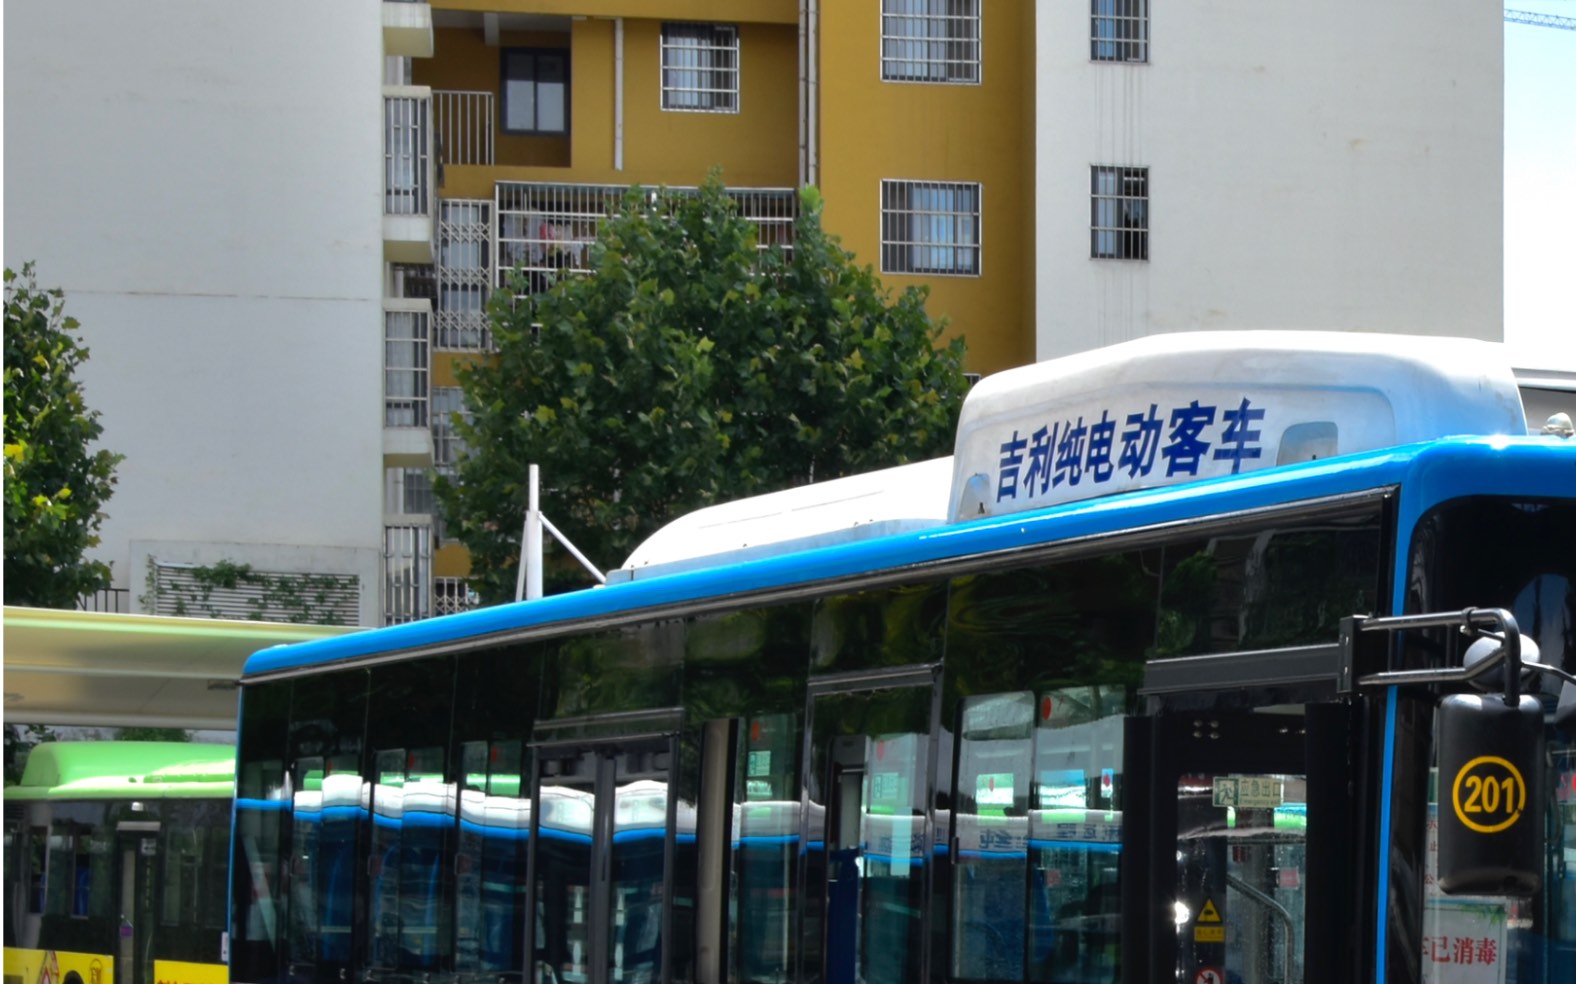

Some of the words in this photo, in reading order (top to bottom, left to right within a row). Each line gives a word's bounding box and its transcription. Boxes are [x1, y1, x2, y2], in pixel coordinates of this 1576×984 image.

[996, 397, 1266, 502] 吉利纯电动客车
[1463, 775, 1516, 814] 201
